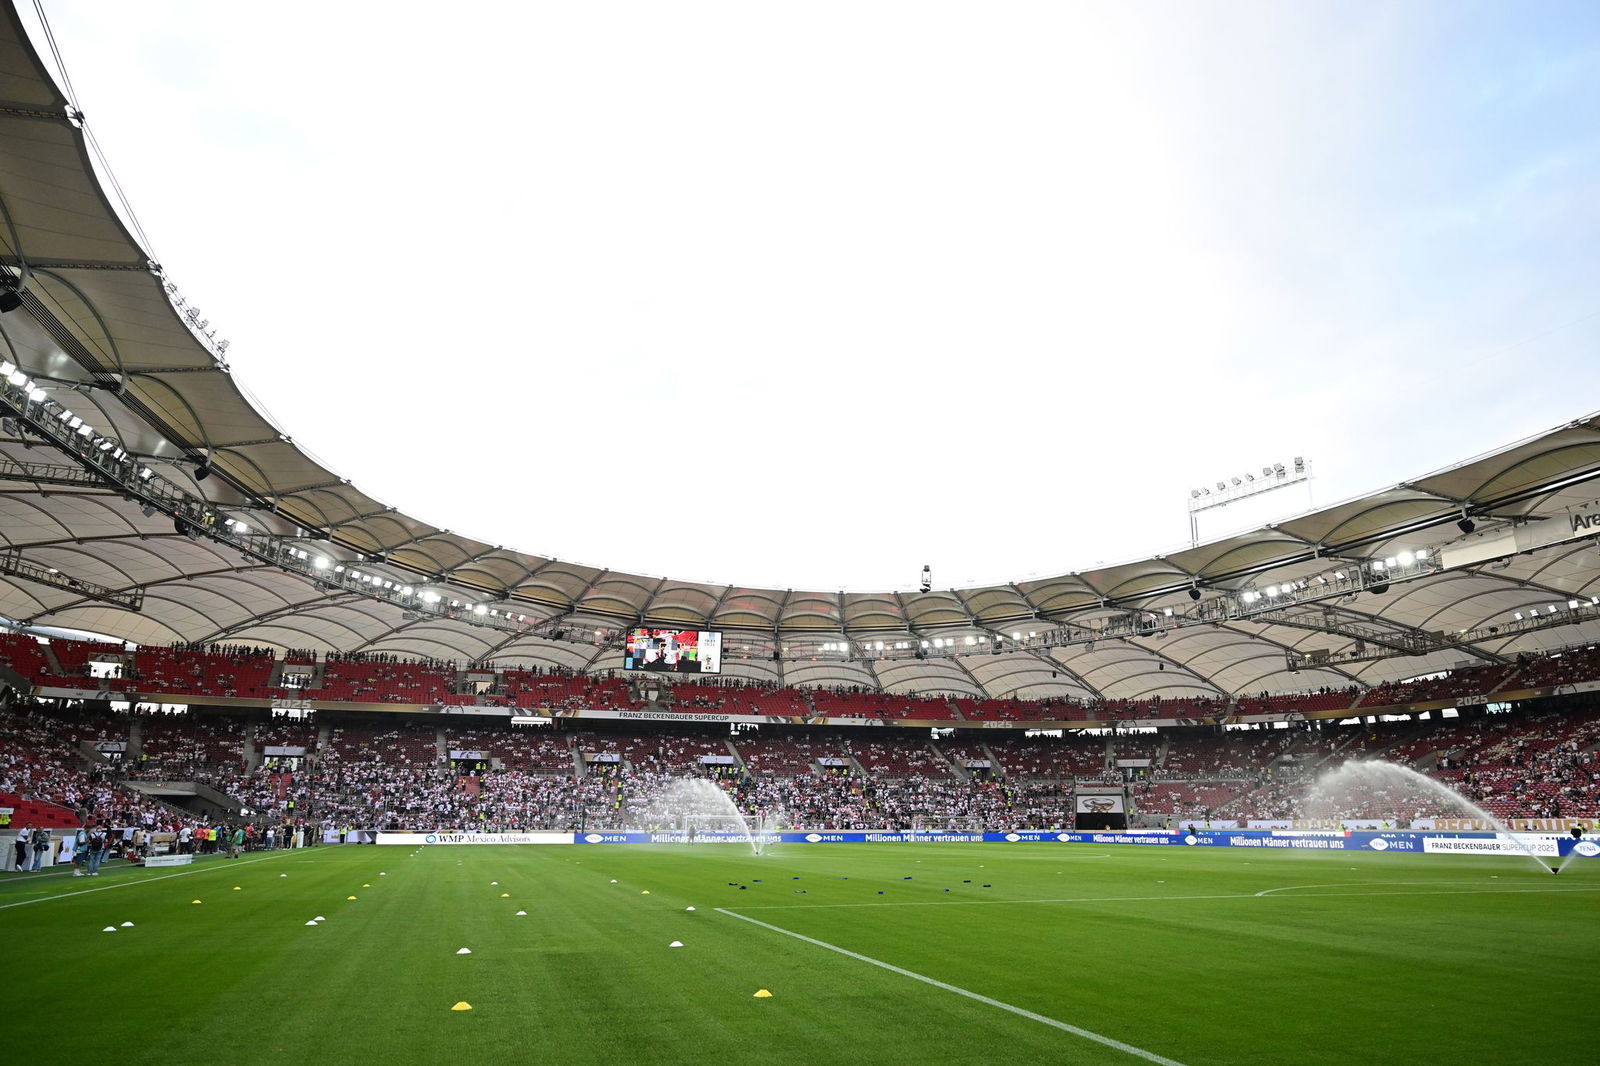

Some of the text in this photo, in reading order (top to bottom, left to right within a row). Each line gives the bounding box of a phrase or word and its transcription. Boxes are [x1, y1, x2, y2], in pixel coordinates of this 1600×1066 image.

[271, 699, 311, 708] 2025
[1456, 695, 1488, 707] 2025
[498, 835, 531, 843] Advisors
[865, 834, 901, 842] Millionen
[1093, 834, 1114, 843] Millionen
[1115, 835, 1133, 844] Männer
[1134, 836, 1158, 844] vertrauen
[1230, 836, 1344, 849] Millionen Männer vertrauen uns
[1389, 841, 1413, 849] MEN
